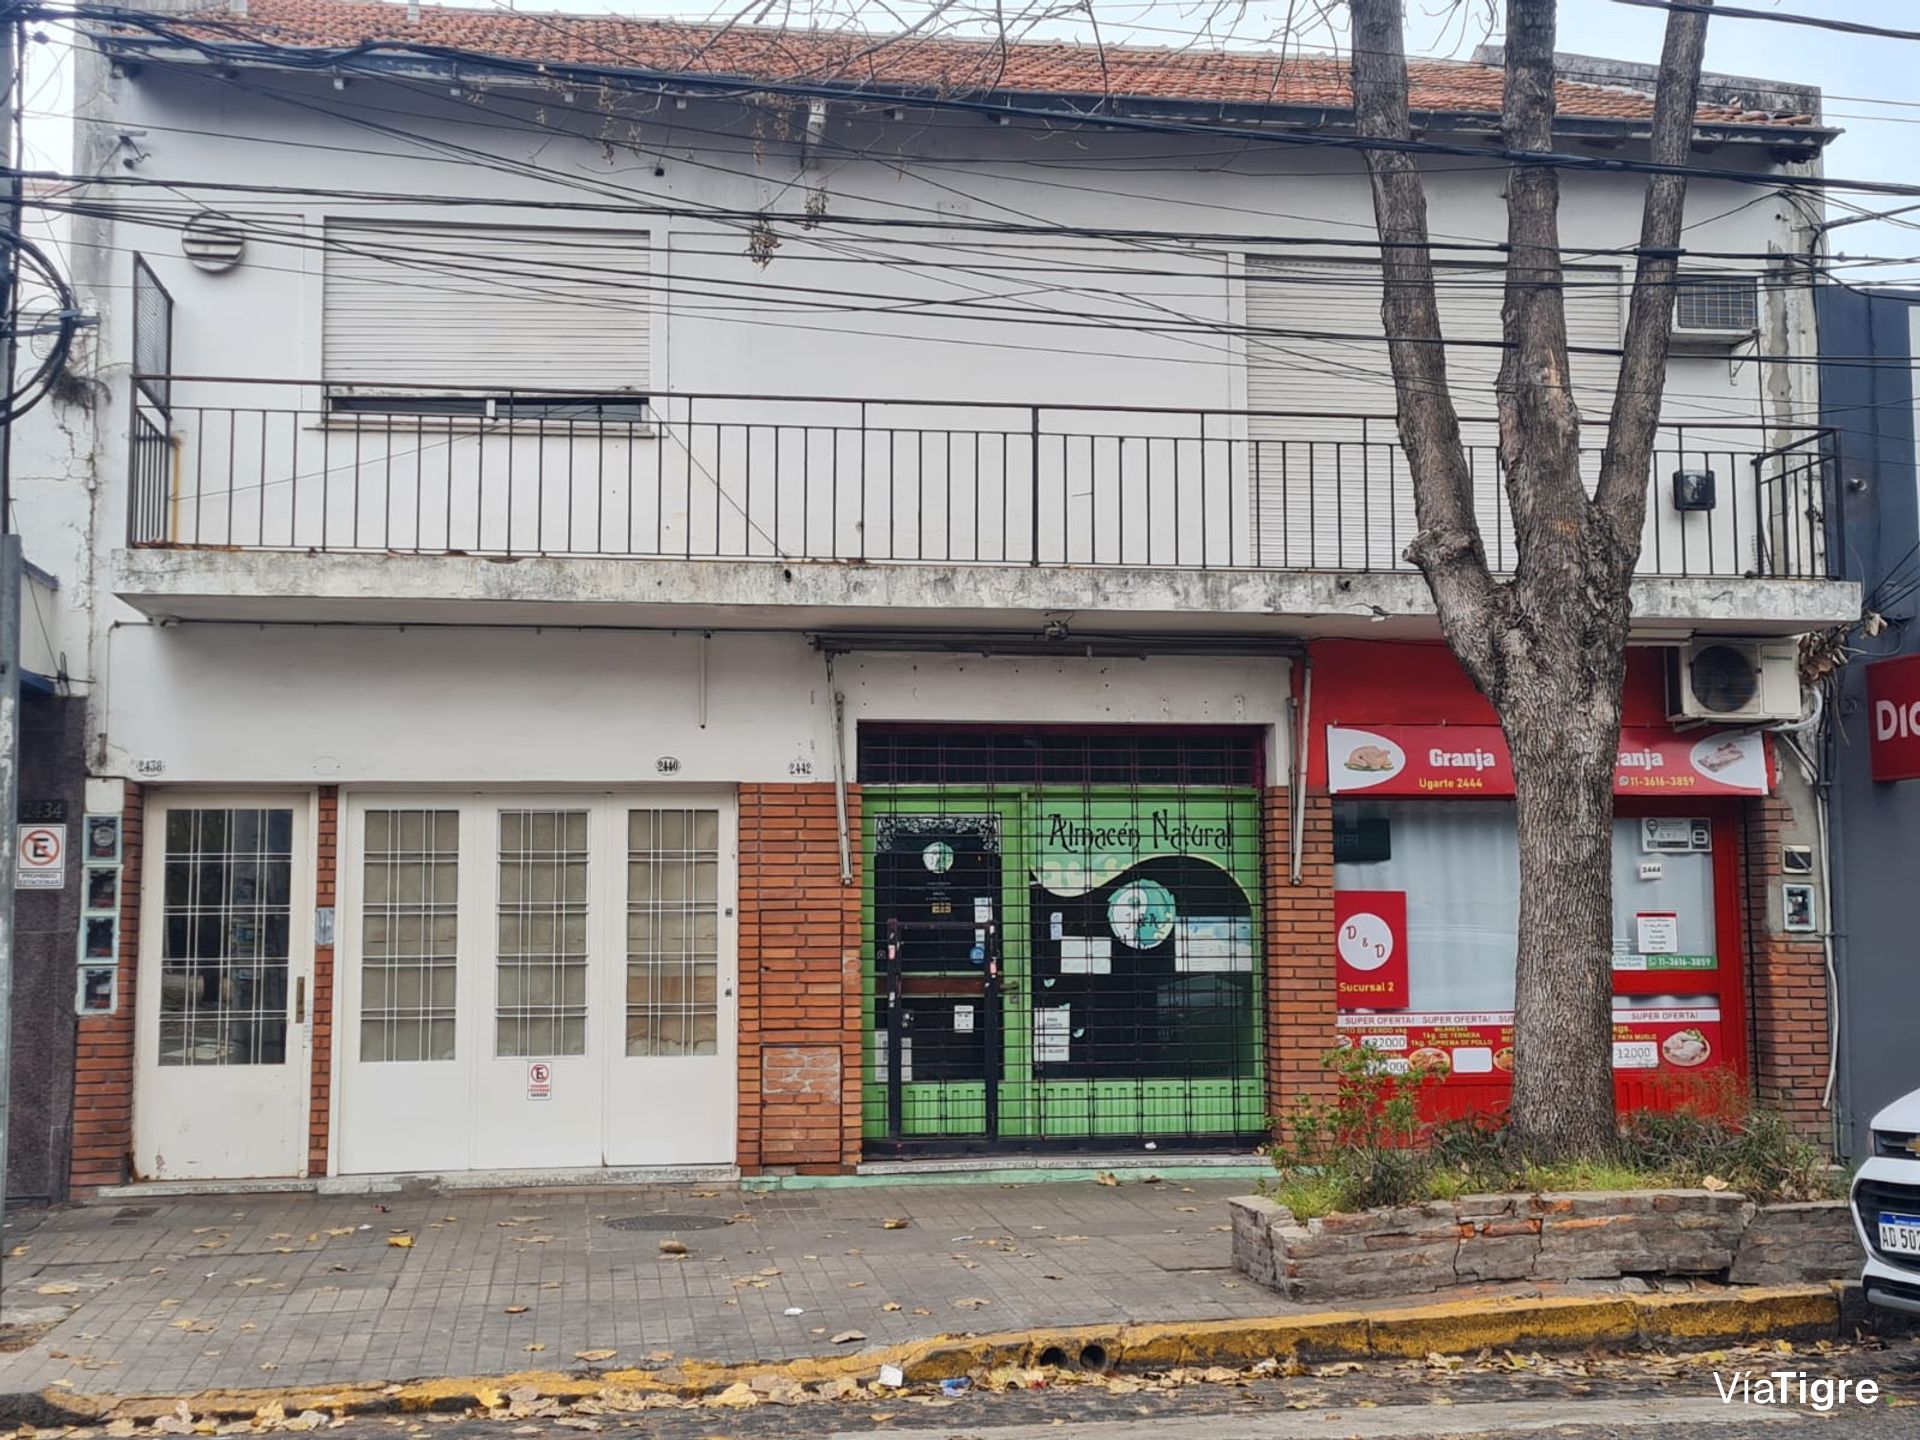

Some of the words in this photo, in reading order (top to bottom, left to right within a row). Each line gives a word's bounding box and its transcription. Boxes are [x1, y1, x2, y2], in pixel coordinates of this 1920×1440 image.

[1428, 749, 1496, 771] Granja
[1616, 749, 1664, 771] anja
[789, 762, 811, 774] 2442
[1419, 778, 1454, 790] Ugarte
[1456, 778, 1482, 788] 2444
[1630, 776, 1695, 787] 11-3616-3859
[1048, 813, 1141, 853] Almacén
[1152, 809, 1232, 850] Natural
[1346, 925, 1357, 940] D
[1362, 938, 1369, 948] &
[1374, 944, 1386, 958] D
[1340, 982, 1385, 992] Sucursal
[1388, 982, 1395, 992] 2
[1345, 1017, 1375, 1025] SUPER
[1377, 1016, 1414, 1024] OFERTA!
[1422, 1015, 1451, 1024] SUPER
[1453, 1015, 1490, 1023] OFERTA!
[1631, 1012, 1659, 1020] SUPER
[1662, 1011, 1698, 1019] OFERTA!
[1882, 1226, 1897, 1248] AD
